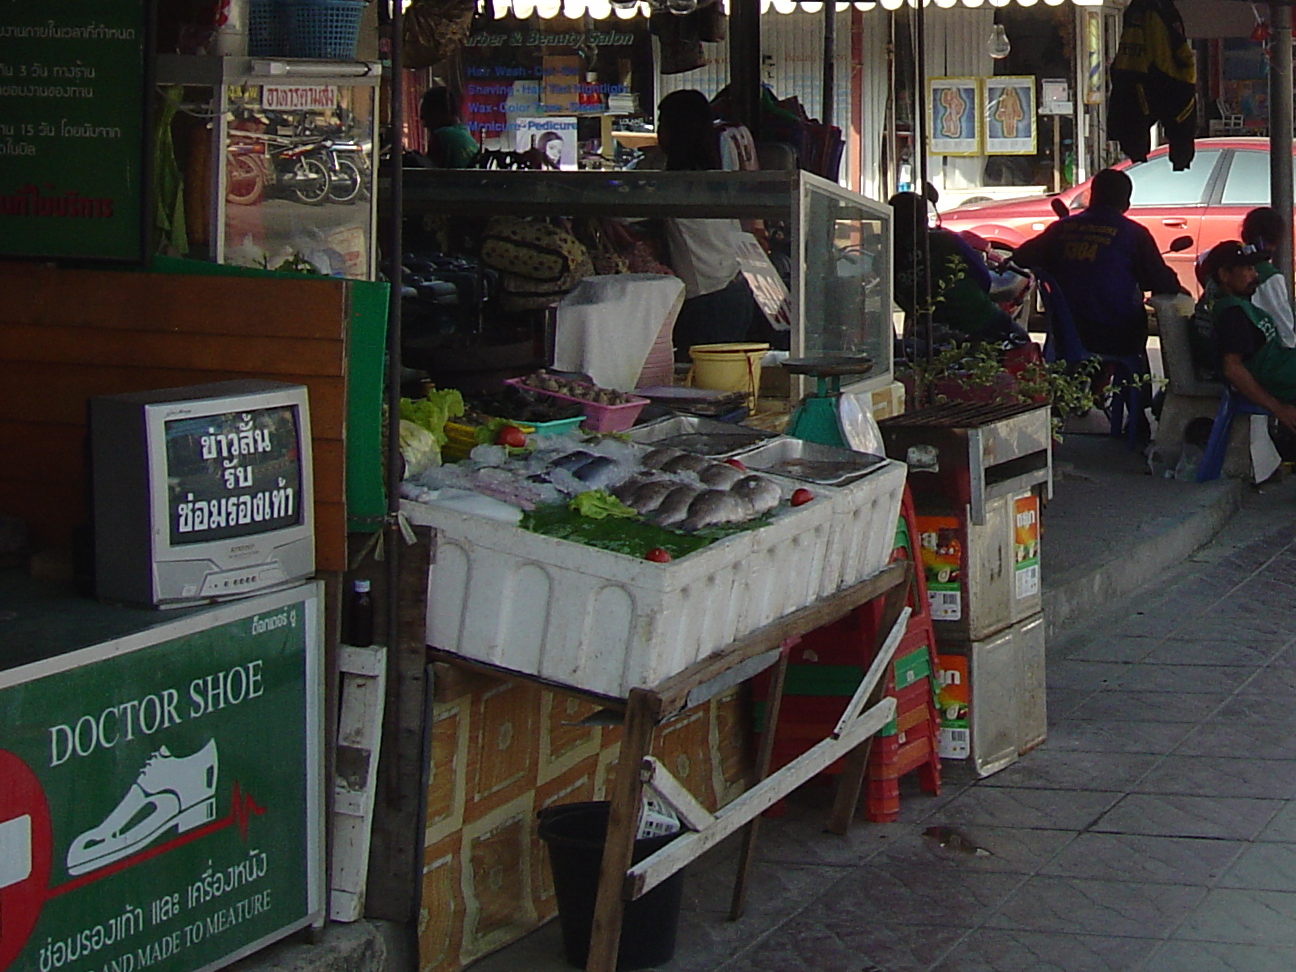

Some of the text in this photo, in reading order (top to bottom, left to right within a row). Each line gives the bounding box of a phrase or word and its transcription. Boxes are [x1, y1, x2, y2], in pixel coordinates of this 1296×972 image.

[526, 31, 585, 48] Beauty
[587, 30, 634, 46] Salon
[19, 65, 27, 77] 3
[21, 124, 34, 136] 15
[201, 414, 271, 459] ข่าวสั้น
[223, 459, 253, 489] รับ
[178, 477, 293, 533] ซ่อมรองเท้า
[49, 659, 265, 768] DOCTOR SHOE
[38, 849, 267, 972] ซ่อมรองเท้า และ เครื่องหนัง
[137, 931, 181, 969] MADE
[184, 921, 203, 947] TO
[206, 889, 272, 937] MEATURE
